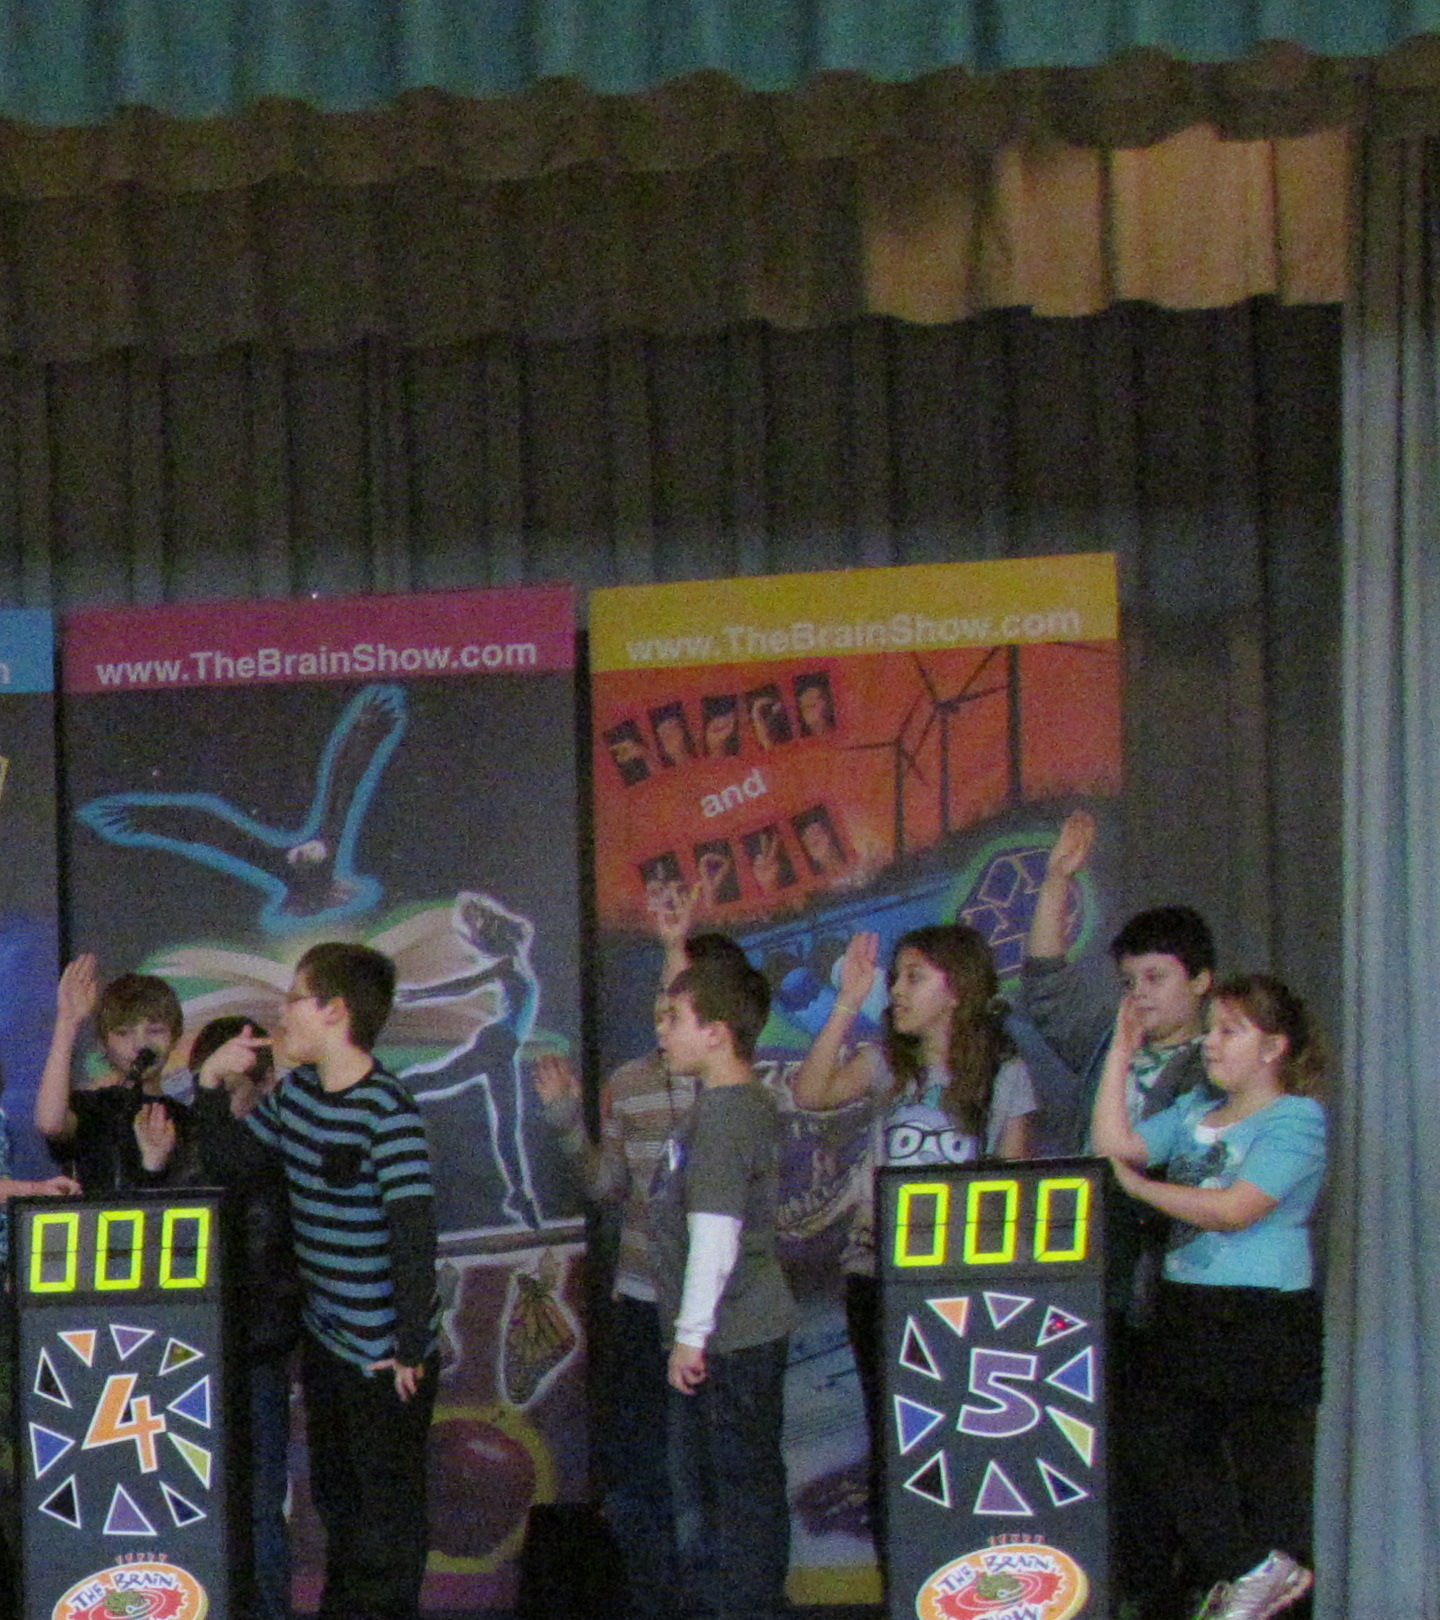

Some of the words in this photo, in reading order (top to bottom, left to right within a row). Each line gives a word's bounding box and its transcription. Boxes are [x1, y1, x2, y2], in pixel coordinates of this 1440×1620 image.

[95, 636, 537, 686] www.TheBrainShow.com
[625, 605, 1082, 665] www.TheBrainShow.com
[699, 768, 768, 820] and
[956, 1347, 1040, 1438] 5
[82, 1372, 167, 1474] 4
[71, 1582, 105, 1608] THE
[935, 1564, 974, 1591] THE
